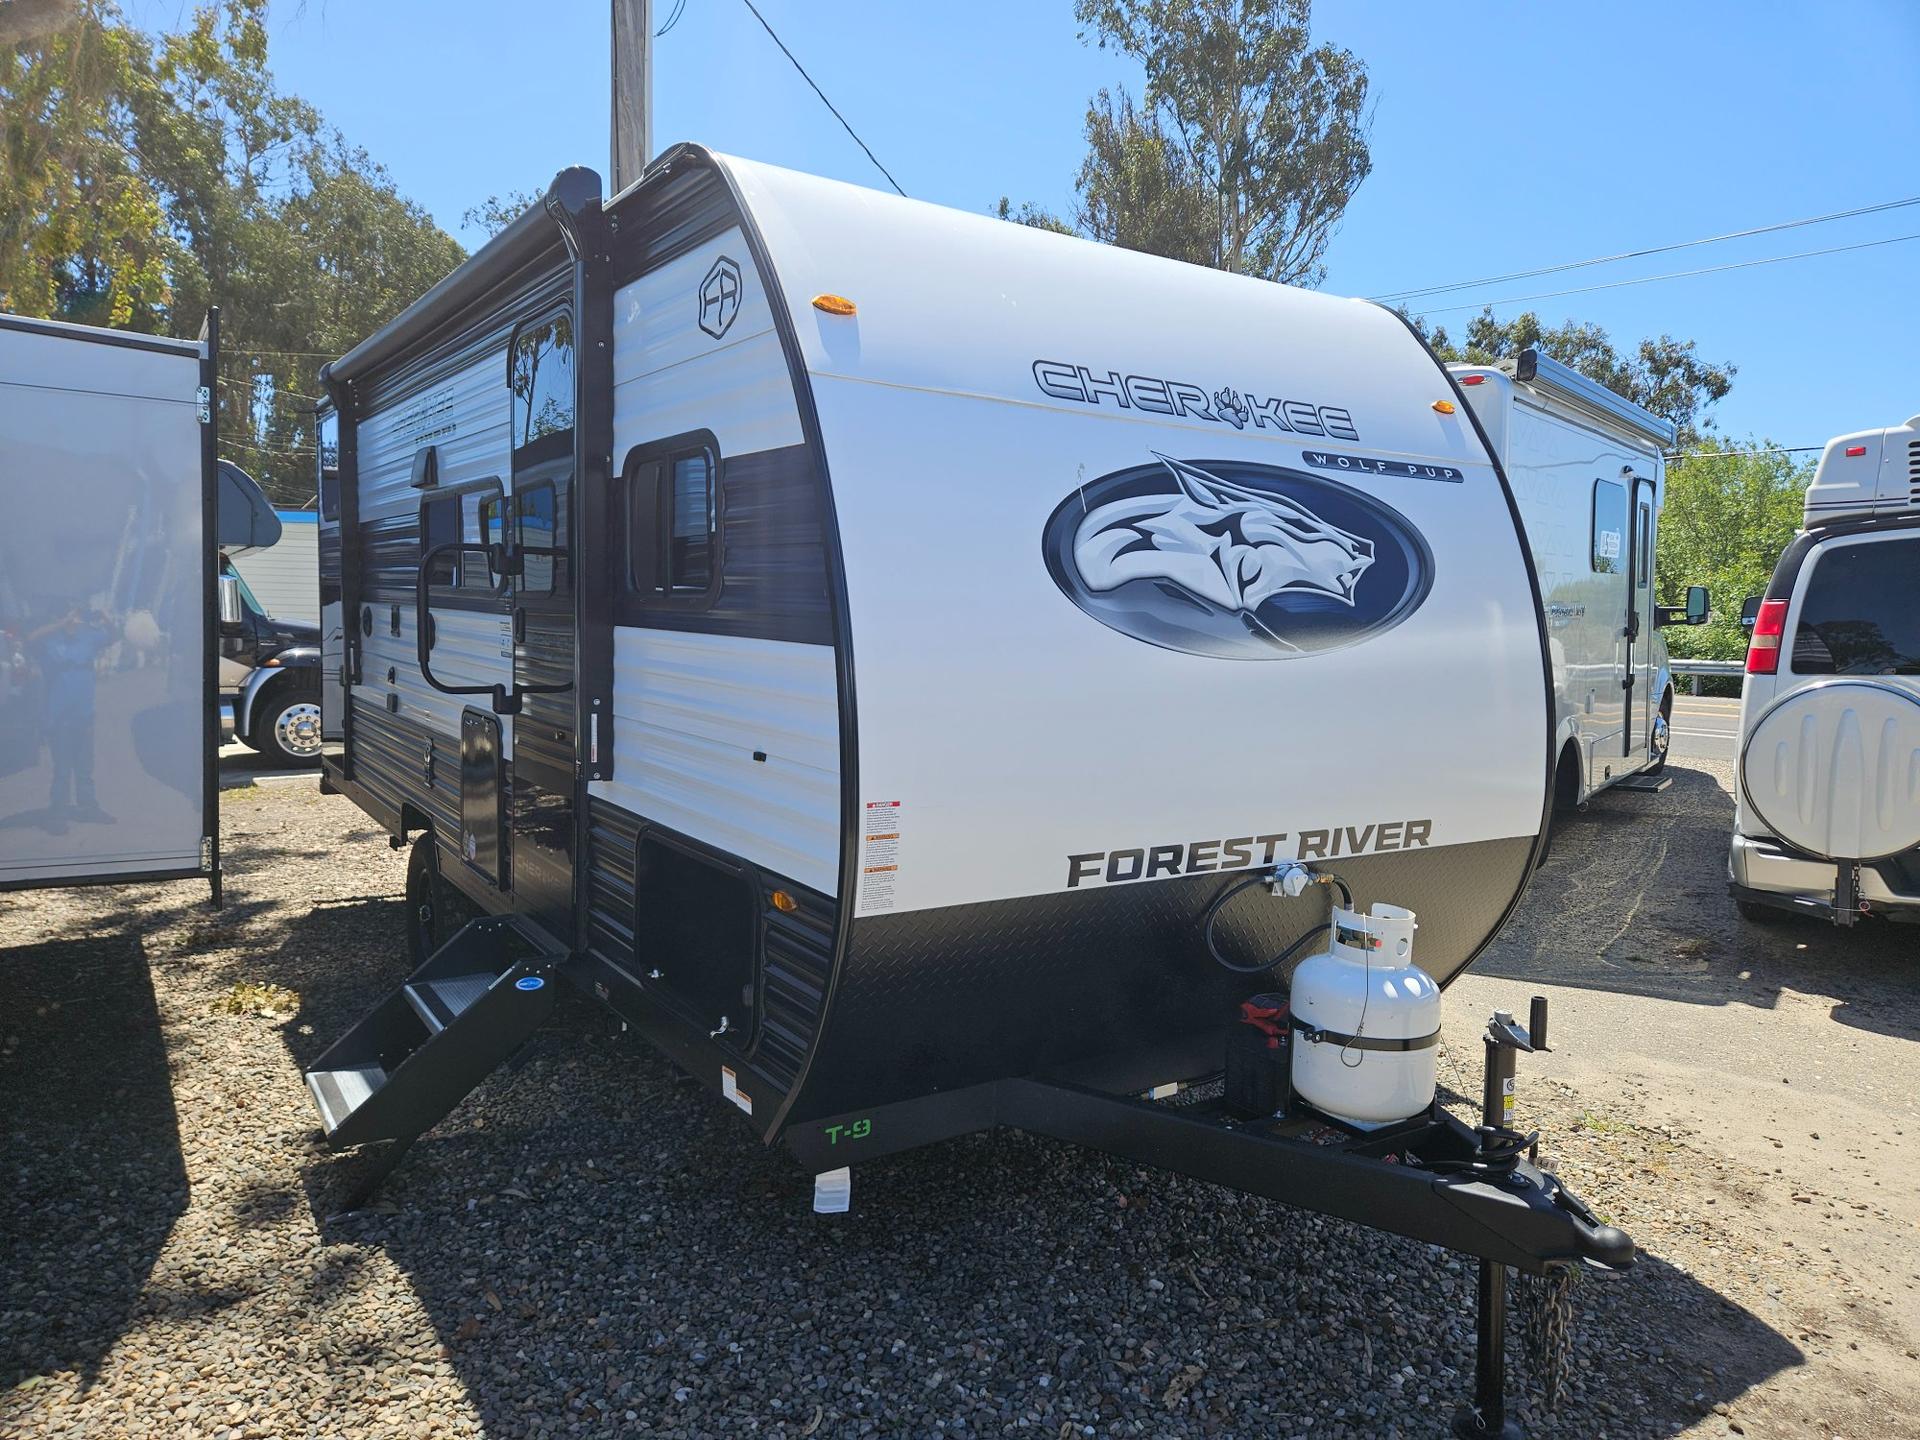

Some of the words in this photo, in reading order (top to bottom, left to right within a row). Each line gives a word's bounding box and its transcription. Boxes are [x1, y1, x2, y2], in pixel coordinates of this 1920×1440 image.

[1032, 360, 1359, 442] CHERKEE
[1313, 453, 1386, 472] WOLF
[1407, 465, 1454, 479] PUP
[1066, 832, 1288, 888] FOREST
[1297, 819, 1432, 861] RIVER
[517, 854, 566, 889] CHERKE
[825, 1119, 871, 1144] T-9
